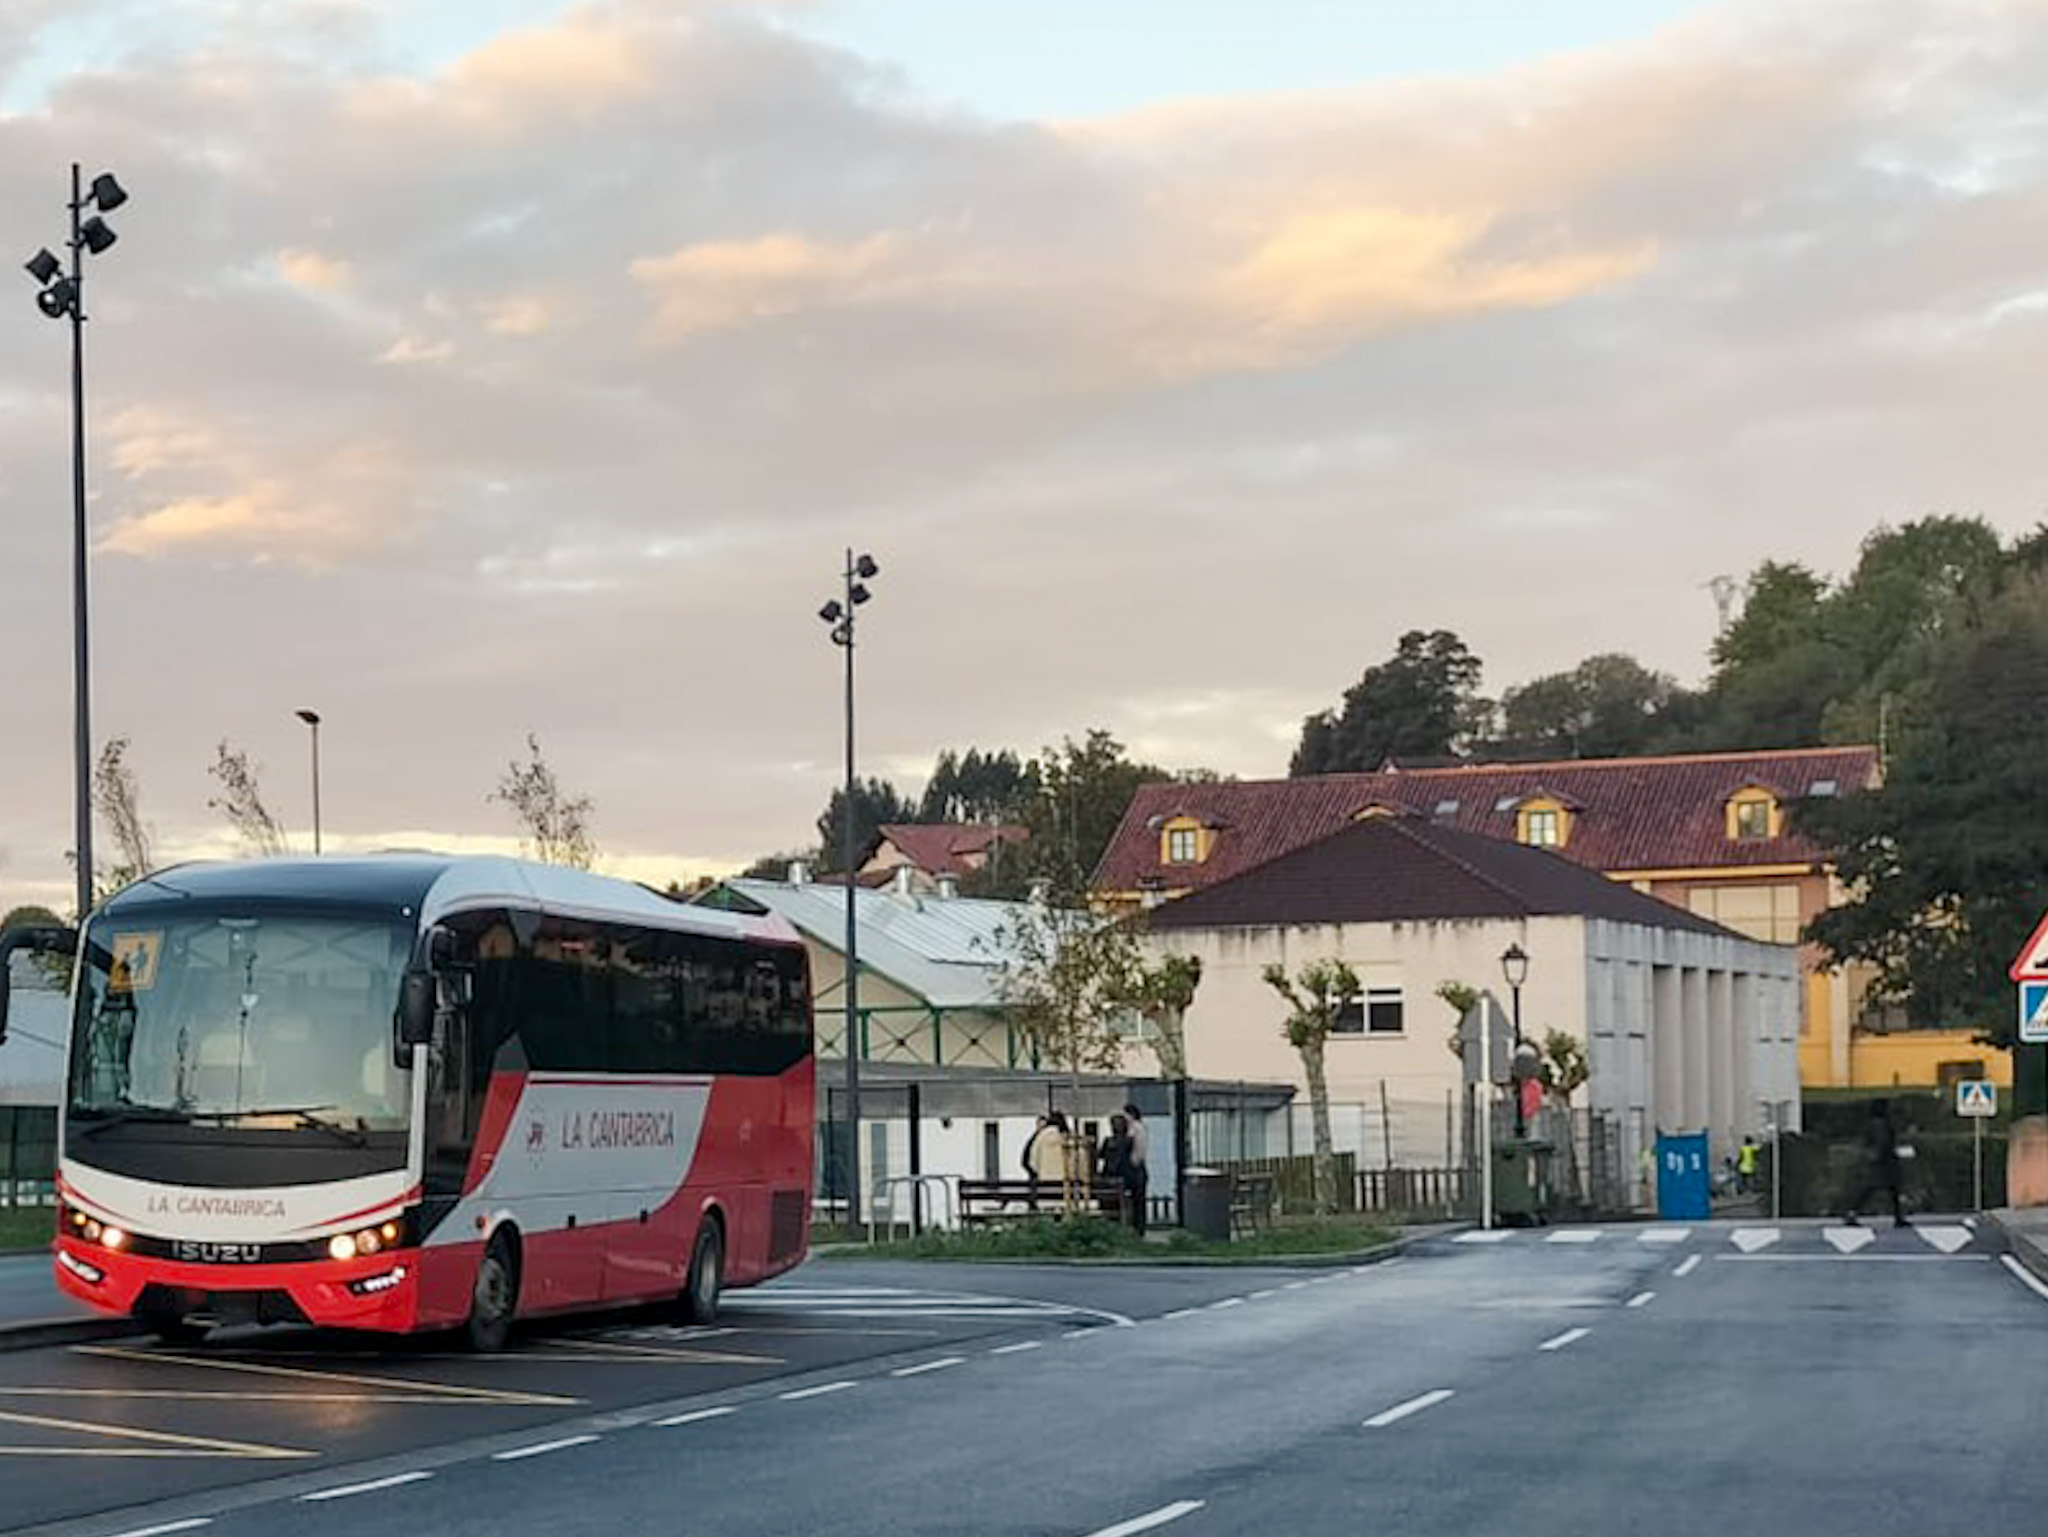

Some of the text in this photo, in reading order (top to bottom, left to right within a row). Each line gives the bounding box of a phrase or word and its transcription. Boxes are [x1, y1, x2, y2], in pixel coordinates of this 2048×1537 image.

[562, 1111, 675, 1149] LA CANTABRICA
[148, 1196, 286, 1217] LA CANTABRICA
[171, 1240, 262, 1263] ISUZU
